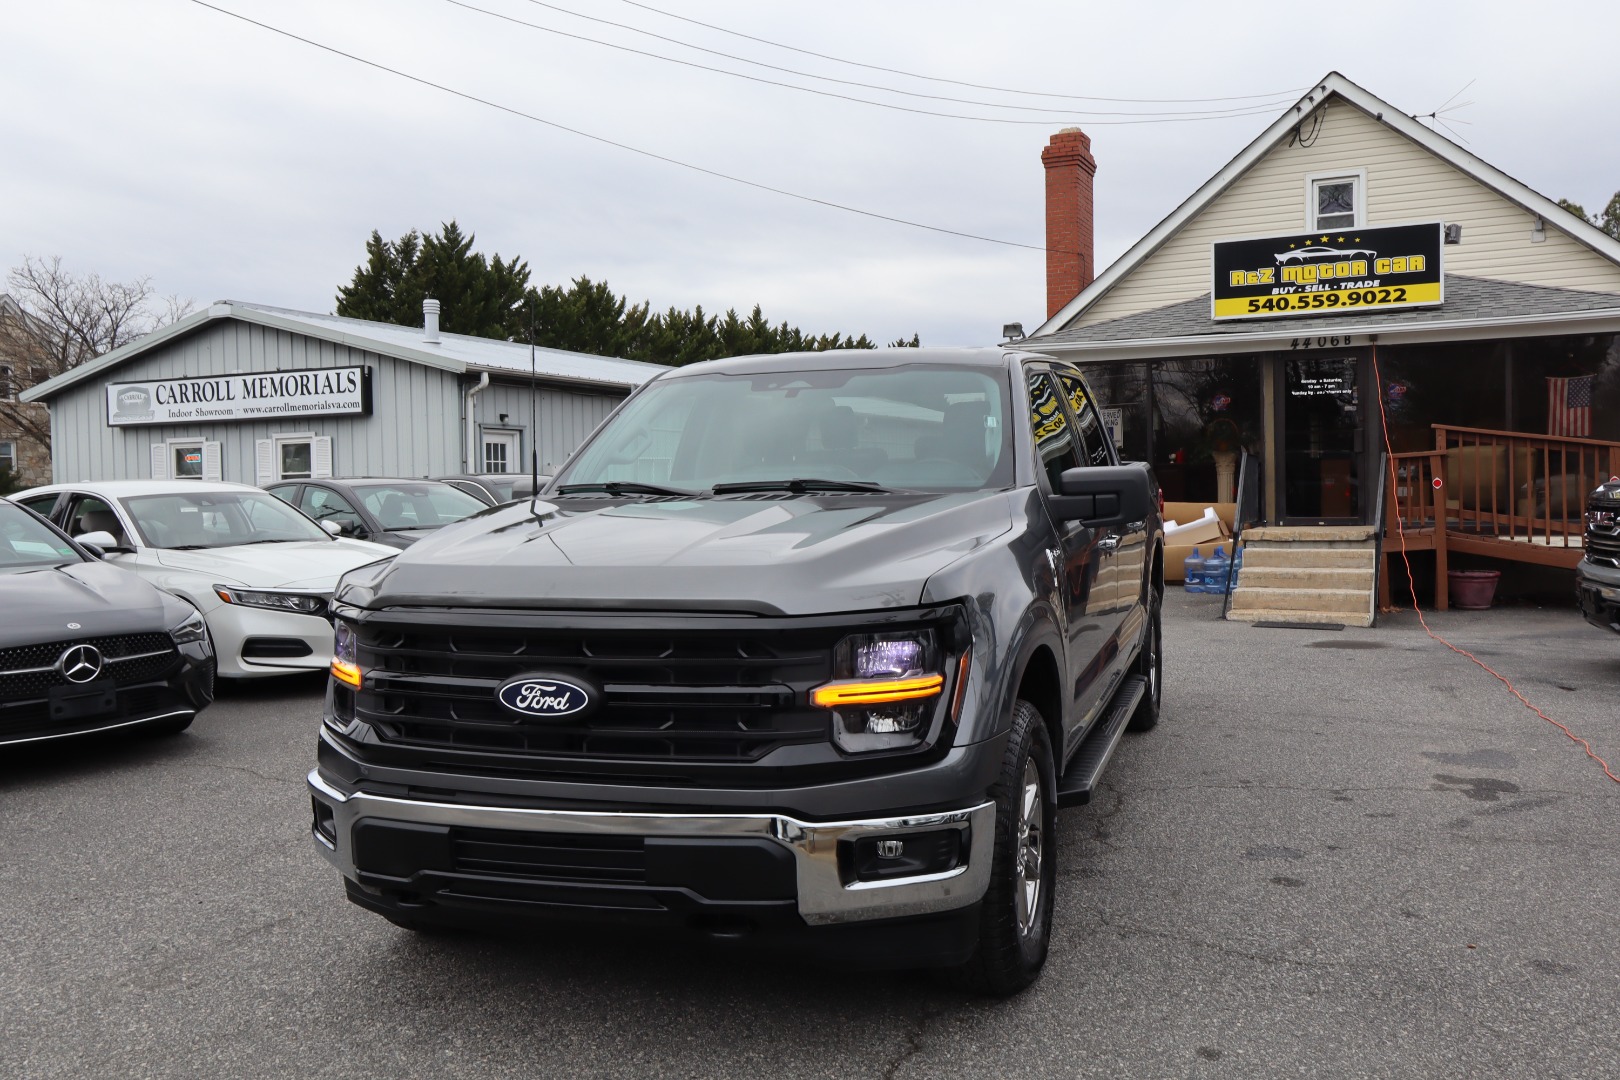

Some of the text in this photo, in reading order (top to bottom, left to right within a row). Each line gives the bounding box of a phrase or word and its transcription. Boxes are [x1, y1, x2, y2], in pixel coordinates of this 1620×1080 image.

[1230, 267, 1275, 287] A&Z
[1271, 286, 1297, 295] BUY
[1304, 284, 1331, 293] SELL
[1340, 280, 1380, 290] TRADE
[1247, 288, 1407, 313] 540.559.9022
[156, 371, 357, 405] CARROLL MEMORIALS
[168, 408, 193, 418] Indoor
[195, 407, 234, 417] Showroom
[243, 401, 360, 414] www.carrollmemorialsva.com
[516, 684, 571, 710] Ford
